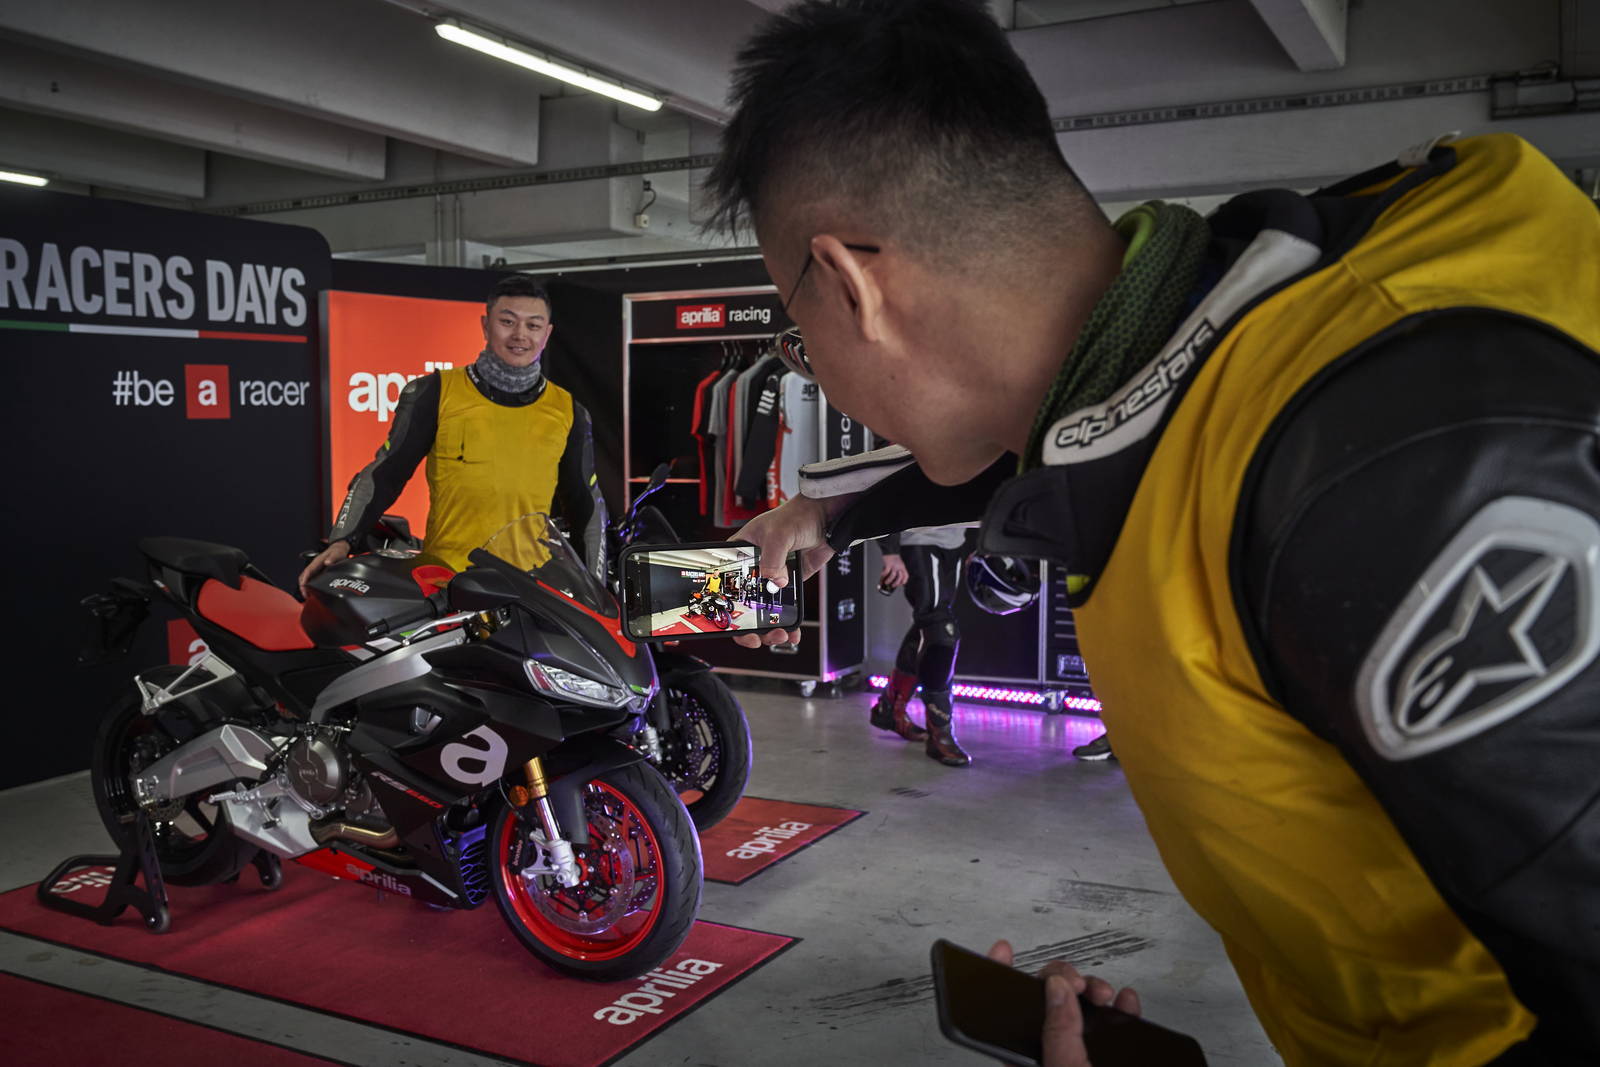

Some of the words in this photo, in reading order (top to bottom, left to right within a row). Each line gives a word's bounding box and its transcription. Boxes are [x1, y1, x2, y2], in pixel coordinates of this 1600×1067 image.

[206, 259, 307, 327] DAYS
[681, 307, 721, 326] aprilia
[729, 306, 771, 324] racing
[113, 370, 175, 407] #be
[198, 382, 218, 406] a
[239, 380, 310, 406] racer
[841, 411, 851, 458] rac
[329, 578, 370, 593] aprilia
[726, 820, 814, 860] aprilia
[346, 863, 412, 896] aprilia
[593, 956, 724, 1026] aprilia
